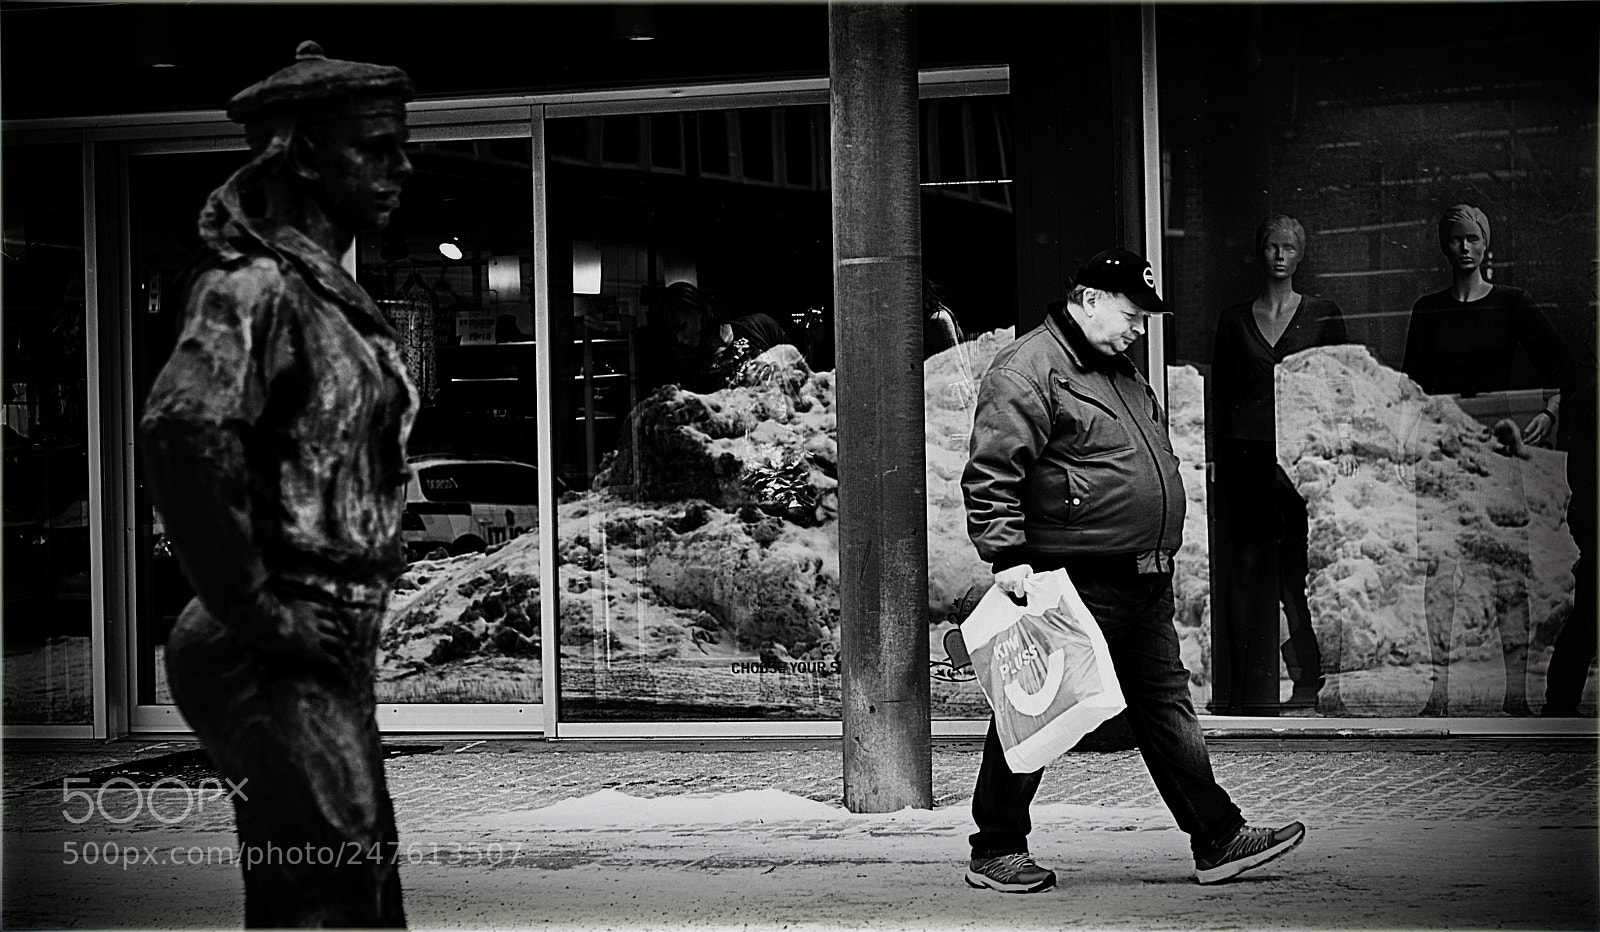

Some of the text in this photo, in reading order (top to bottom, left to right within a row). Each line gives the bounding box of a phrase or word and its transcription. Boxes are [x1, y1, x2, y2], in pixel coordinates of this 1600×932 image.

[993, 633, 1019, 660] KIWI
[731, 661, 840, 674] CHOOSE YOUR S
[999, 644, 1038, 681] PLUSS
